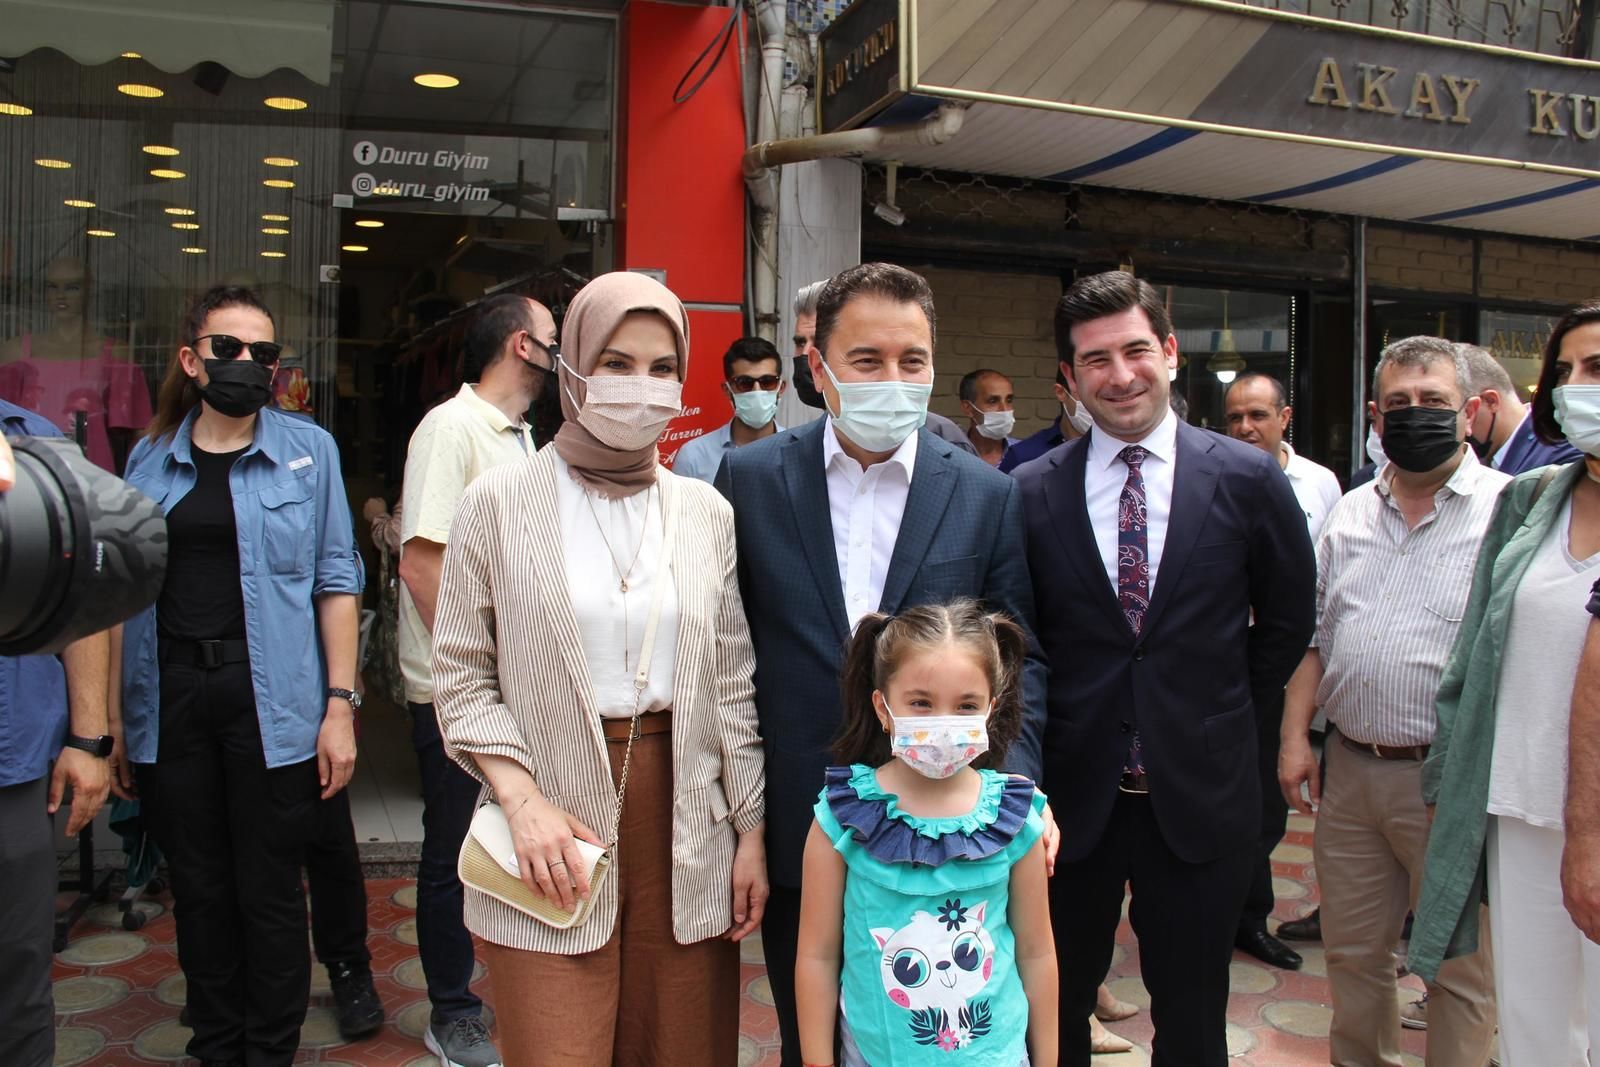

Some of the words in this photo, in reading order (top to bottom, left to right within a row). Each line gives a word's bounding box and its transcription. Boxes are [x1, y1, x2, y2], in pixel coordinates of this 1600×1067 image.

[1307, 57, 1480, 124] AKAY
[1527, 88, 1600, 140] KU
[379, 147, 429, 166] Duru
[434, 150, 489, 171] Giyim
[379, 179, 490, 203] duru_giyim
